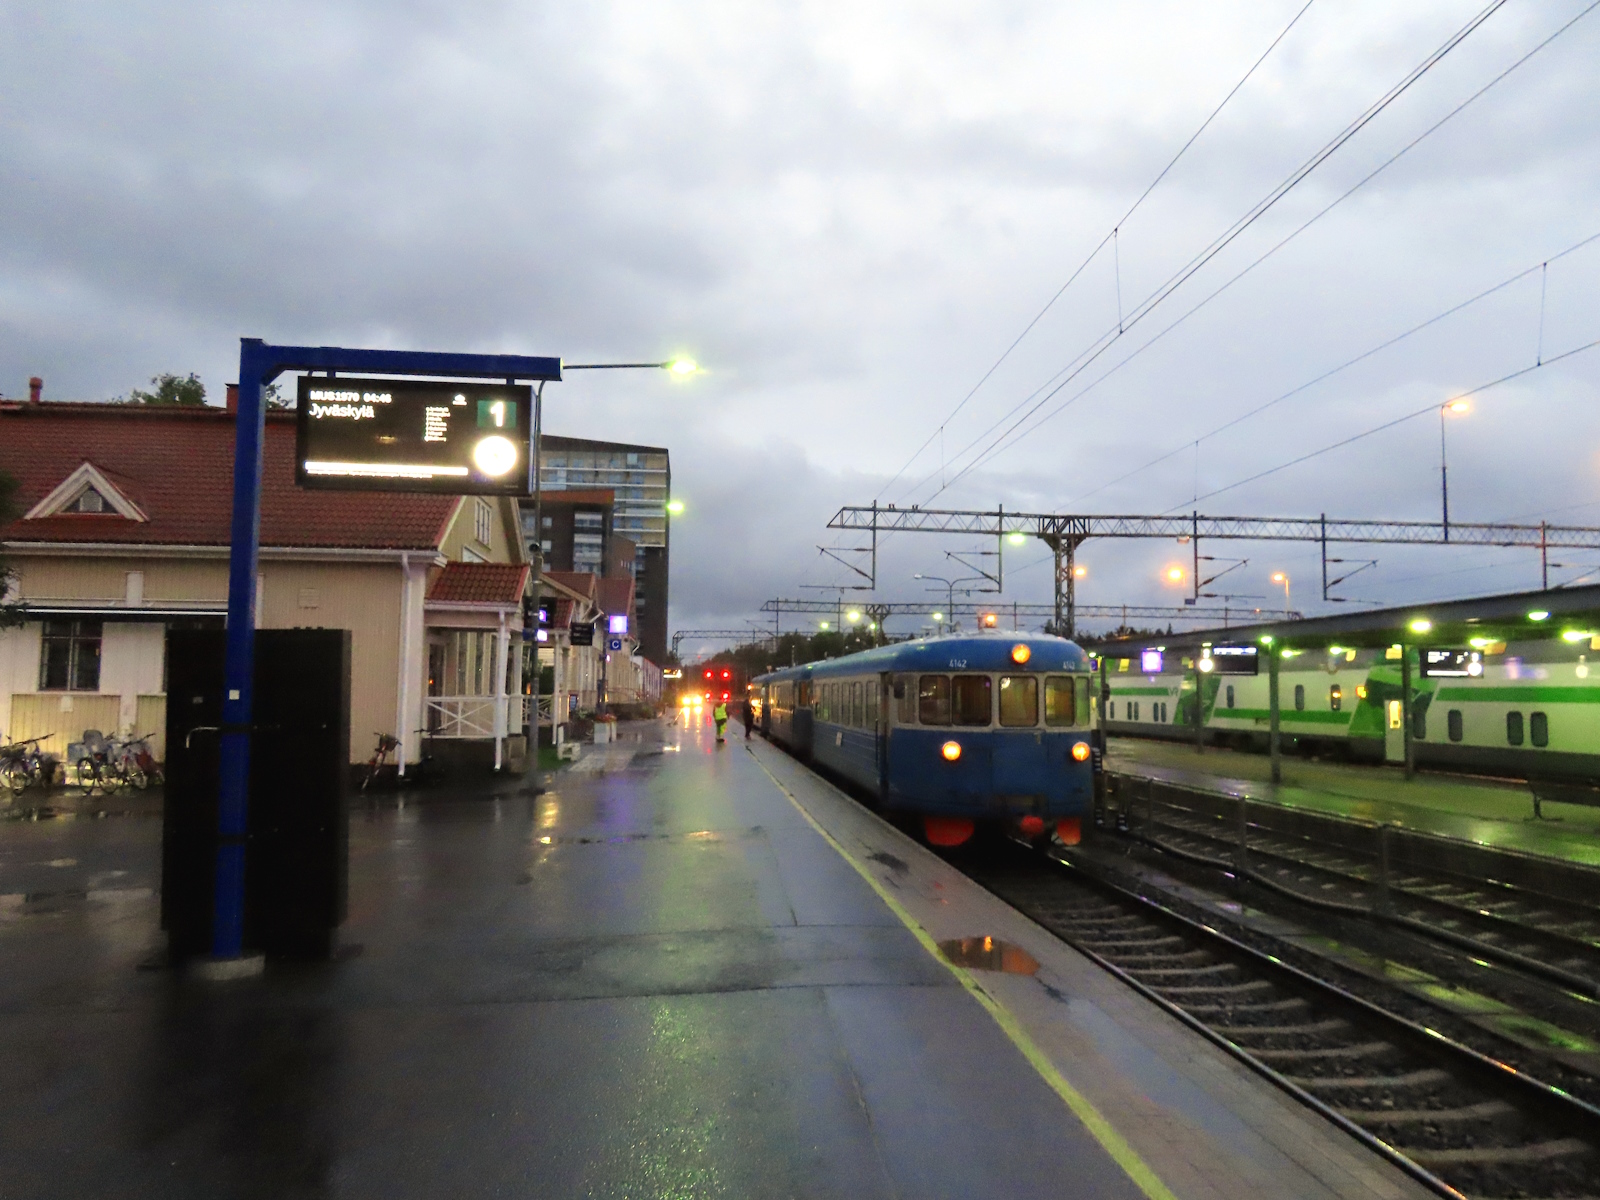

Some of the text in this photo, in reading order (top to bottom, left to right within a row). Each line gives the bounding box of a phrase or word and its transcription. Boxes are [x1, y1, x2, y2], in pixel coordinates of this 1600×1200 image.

[309, 390, 360, 402] MUS1970
[308, 403, 375, 420] Jyväskylä
[490, 401, 504, 427] 1
[613, 616, 624, 632] 1
[611, 640, 620, 649] C
[949, 659, 967, 668] 4142
